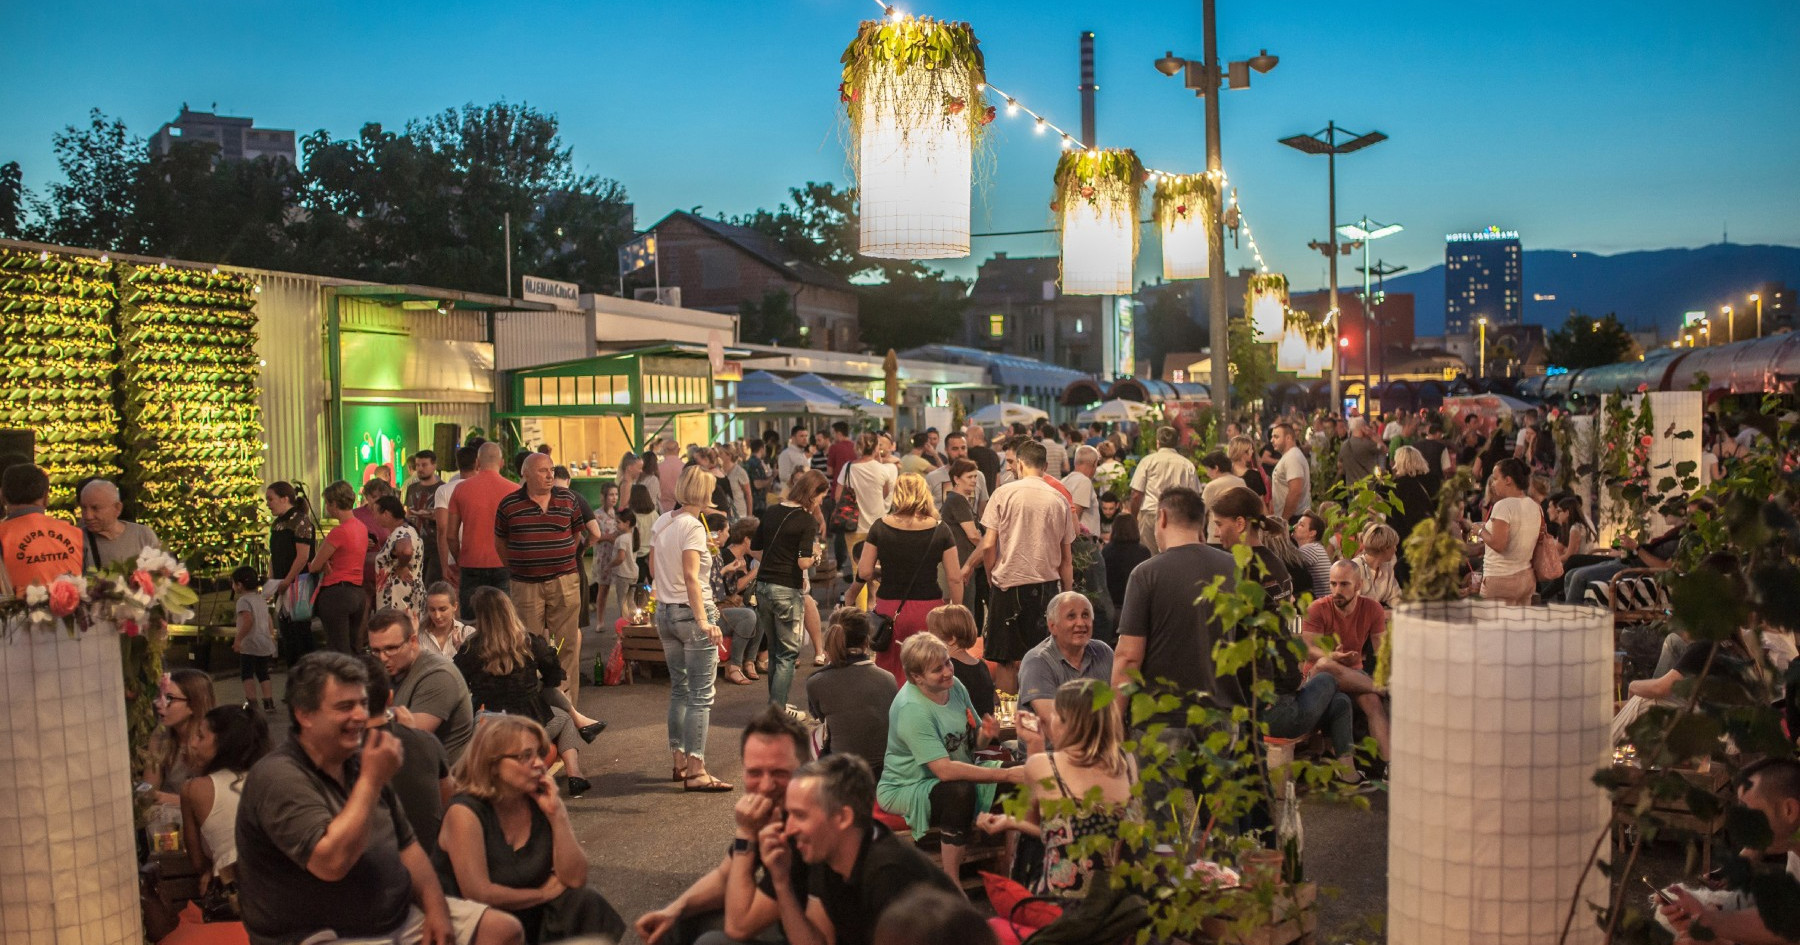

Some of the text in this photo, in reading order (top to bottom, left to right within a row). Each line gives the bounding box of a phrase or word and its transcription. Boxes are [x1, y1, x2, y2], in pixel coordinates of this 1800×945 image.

[1445, 230, 1519, 242] HOTEL PANORAMA
[16, 530, 75, 560] GRUPA GARD
[26, 551, 69, 564] ZAŠTITA
